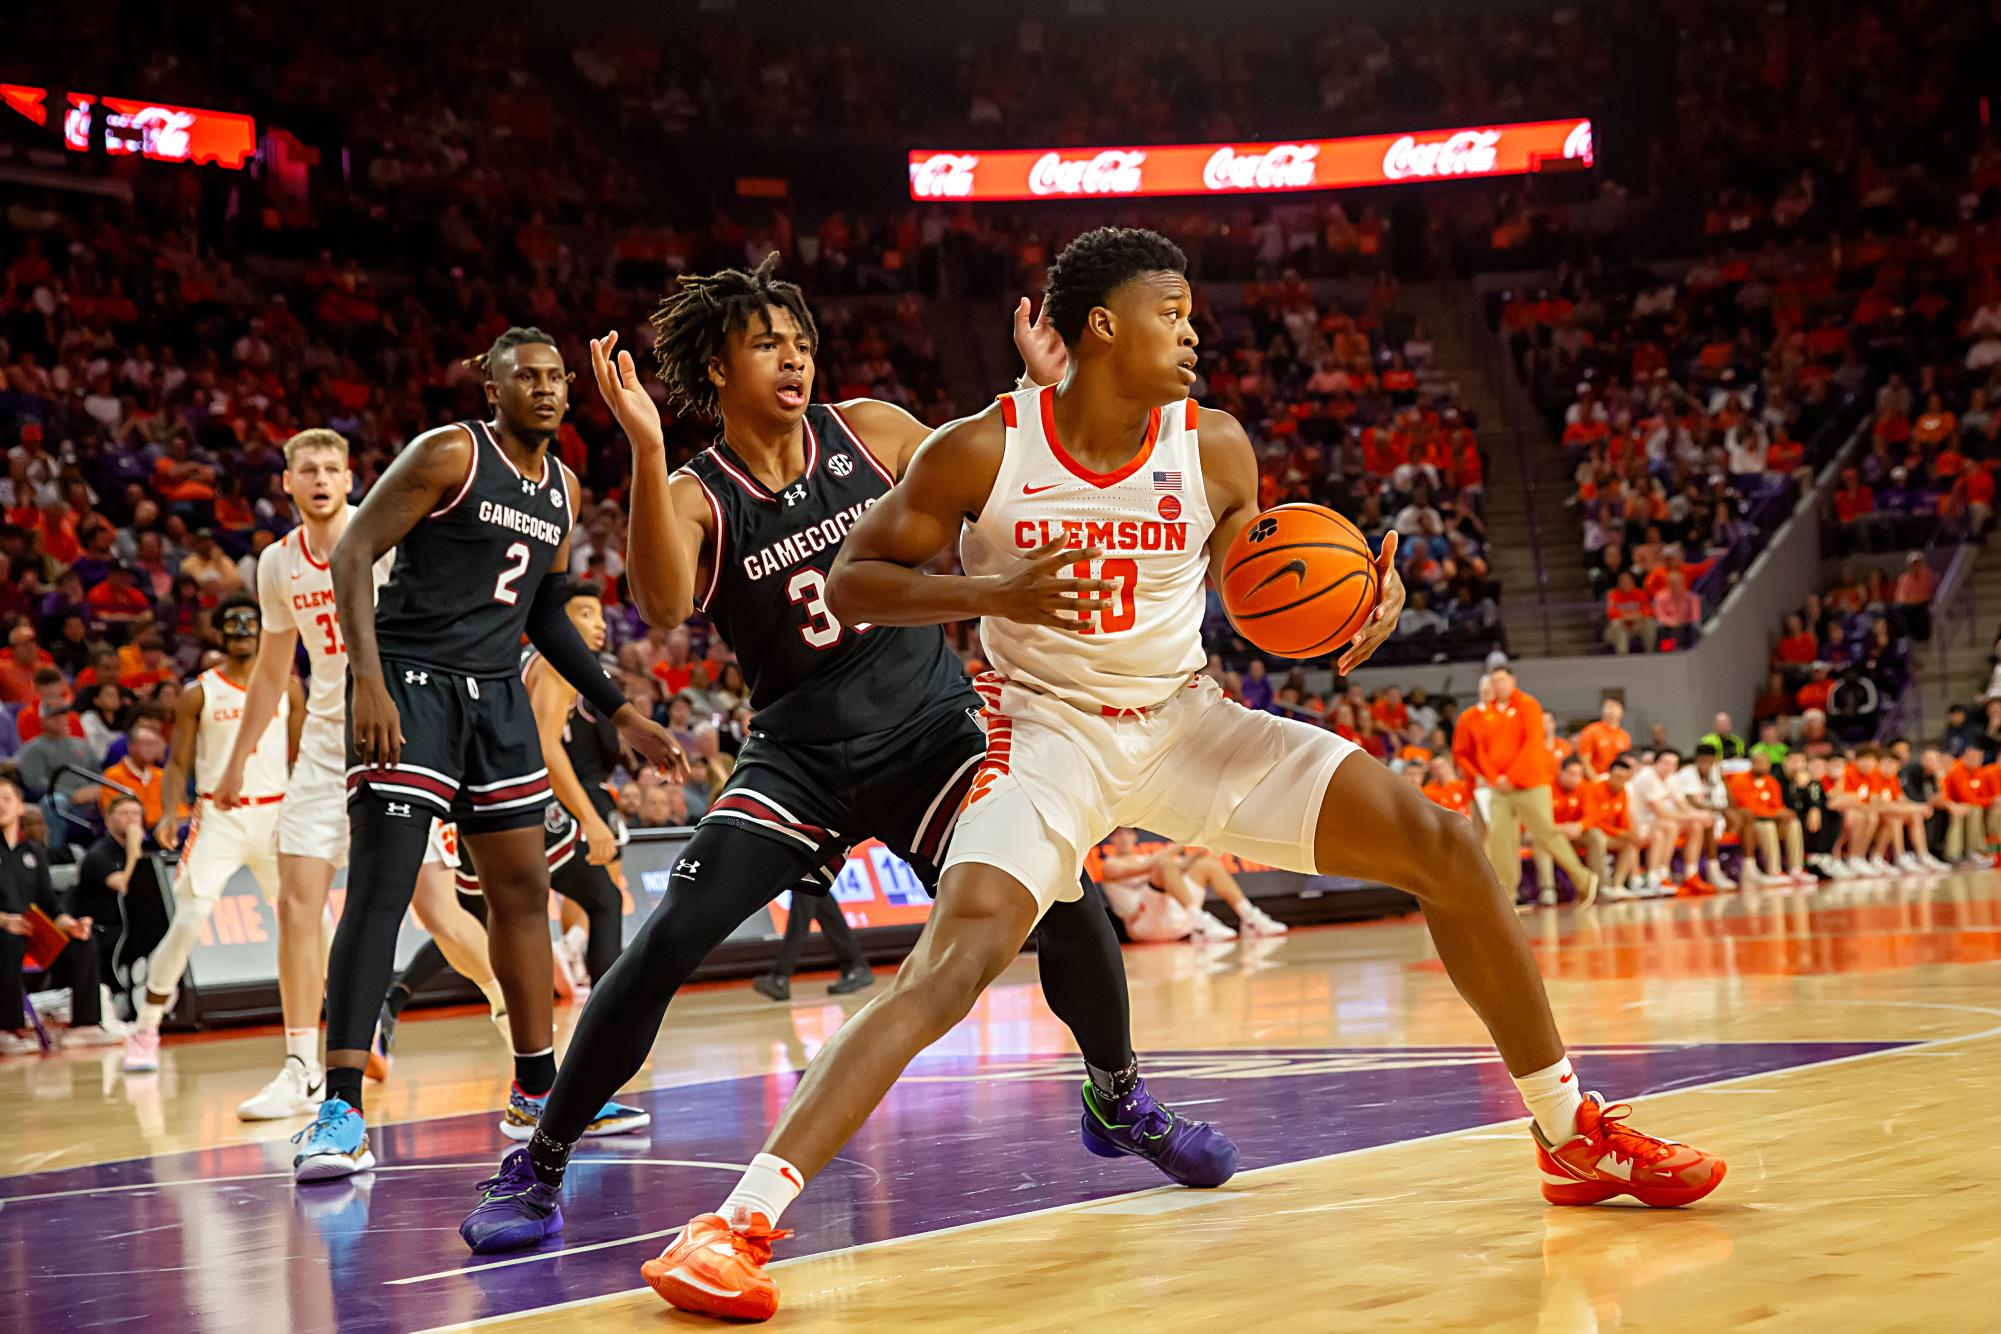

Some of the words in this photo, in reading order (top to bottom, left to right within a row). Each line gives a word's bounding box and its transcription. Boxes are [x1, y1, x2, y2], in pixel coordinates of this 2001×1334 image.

[828, 453, 853, 477] SEC
[479, 501, 561, 546] GAMECOCKS
[1015, 521, 1187, 551] CLEMSON
[494, 541, 530, 607] 2
[293, 589, 336, 611] CLEM
[785, 566, 876, 652] 3
[316, 612, 347, 656] 3
